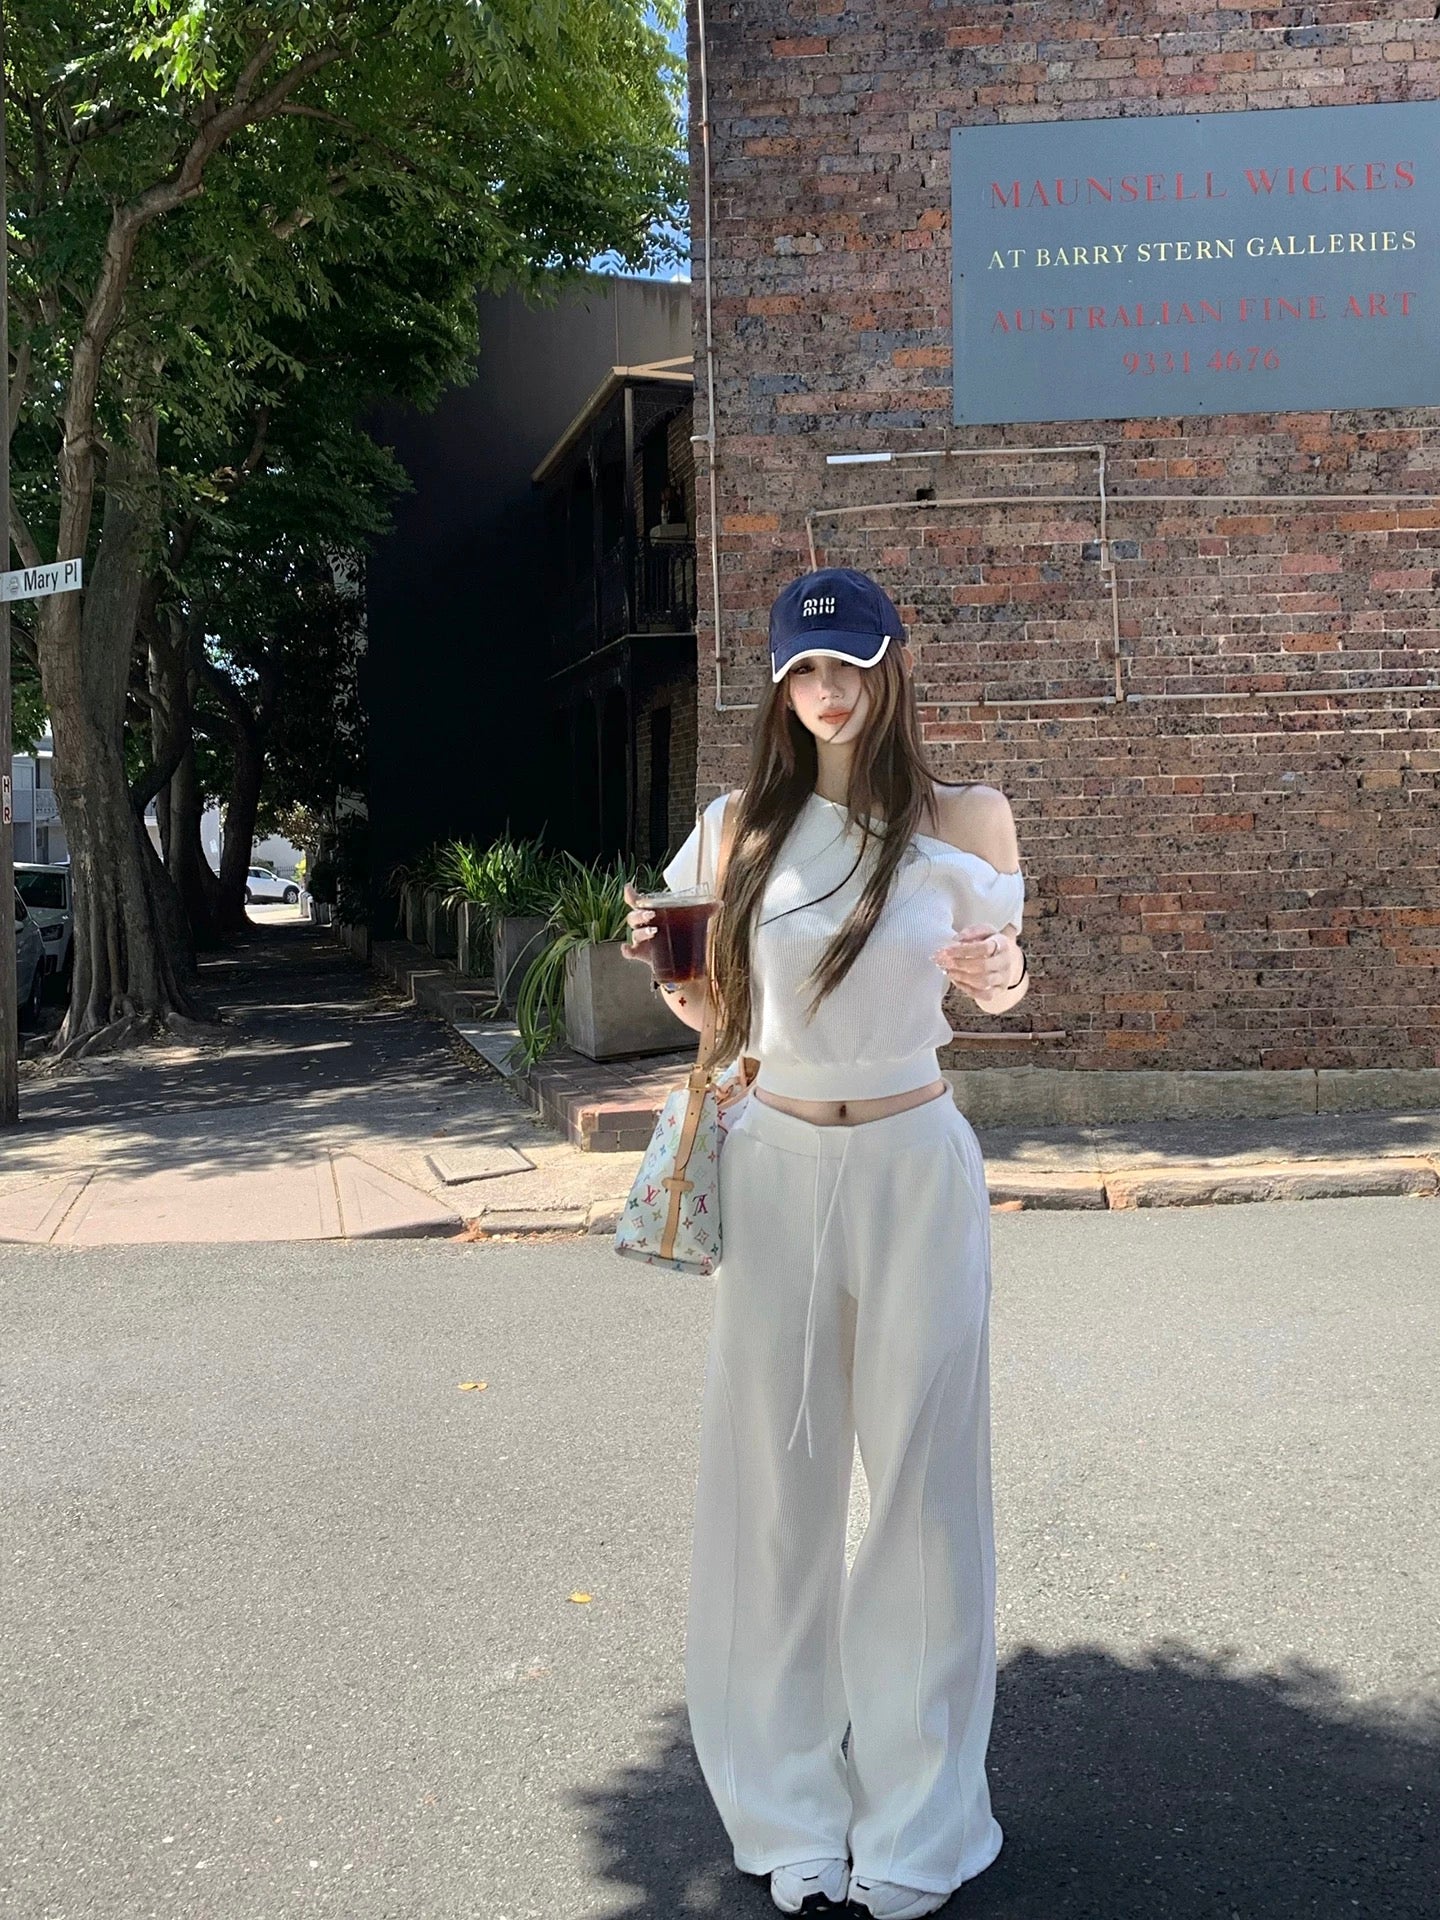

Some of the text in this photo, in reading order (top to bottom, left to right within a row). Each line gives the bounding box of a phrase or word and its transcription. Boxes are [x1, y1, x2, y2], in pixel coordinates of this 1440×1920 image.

[990, 160, 1416, 210] MAUNSELL WICKES
[987, 230, 1418, 270] AT BARRY STERN GALLERIES
[991, 291, 1418, 335] AUSTRALIAN FINE ART
[1122, 348, 1281, 376] 9331 4676
[24, 561, 77, 591] Mary Pl
[4, 779, 9, 792] H
[5, 807, 10, 821] R
